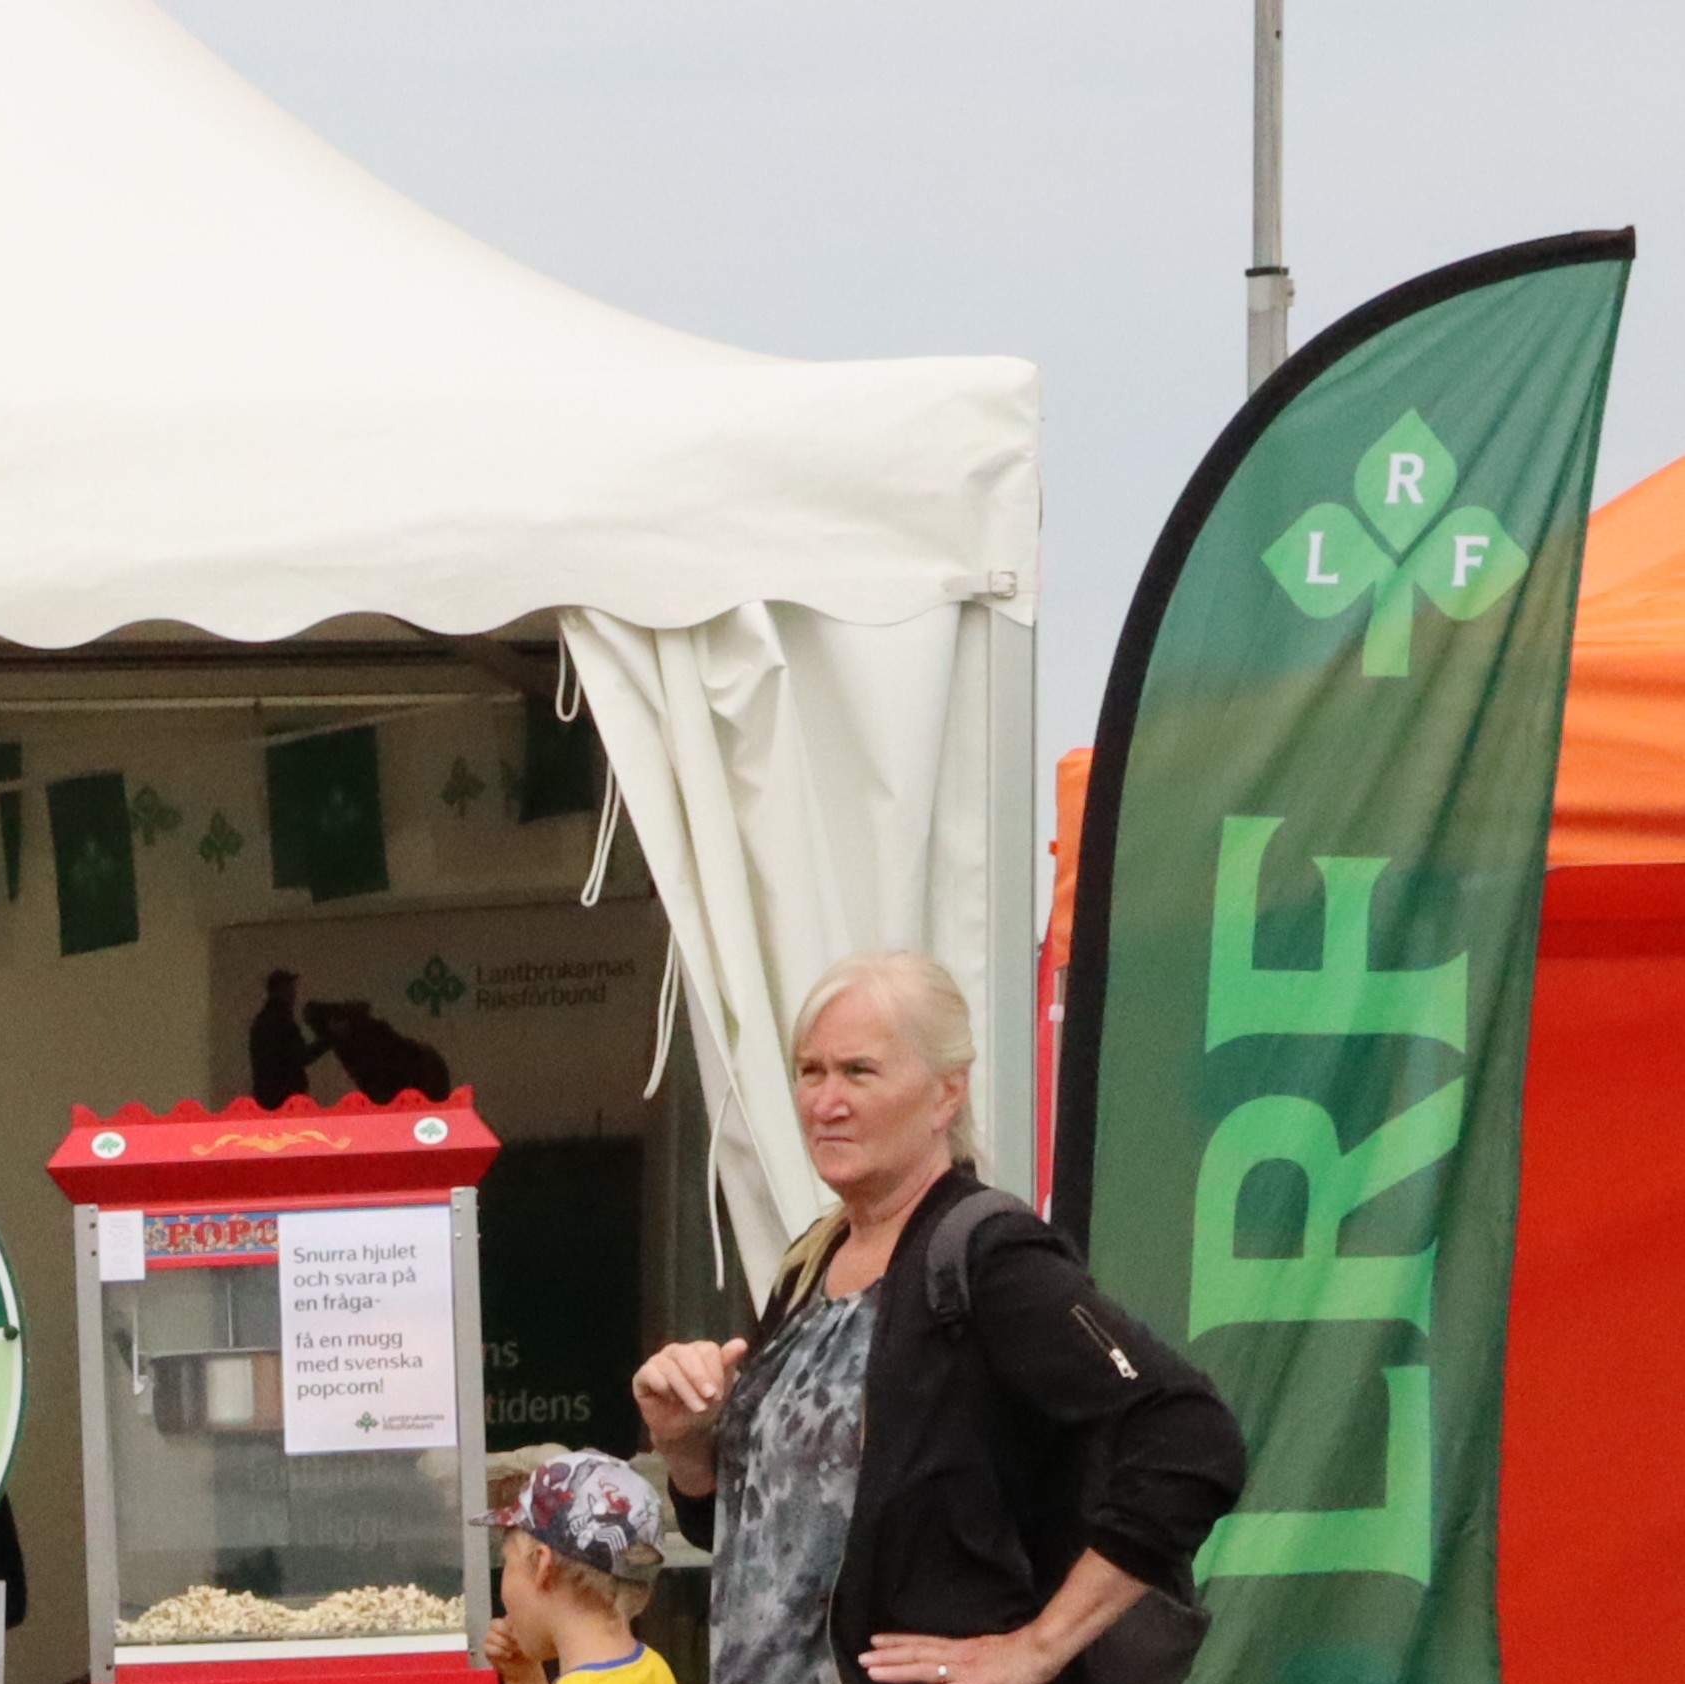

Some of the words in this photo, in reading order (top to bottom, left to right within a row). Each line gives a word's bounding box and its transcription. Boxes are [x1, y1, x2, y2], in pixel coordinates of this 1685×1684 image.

[1188, 815, 1470, 1588] LRF
[166, 1217, 279, 1249] POPC
[293, 1246, 358, 1264] Snurra
[363, 1243, 418, 1265] hjulet
[293, 1270, 330, 1288] och
[335, 1271, 387, 1286] svara
[392, 1266, 417, 1288] på
[294, 1297, 318, 1311] en
[295, 1332, 314, 1349] få
[319, 1333, 342, 1347] en
[347, 1332, 404, 1350] mugg
[296, 1356, 339, 1373] med
[344, 1352, 424, 1370] svenska
[297, 1378, 384, 1400] popcorn!
[485, 1388, 593, 1425] tidens
